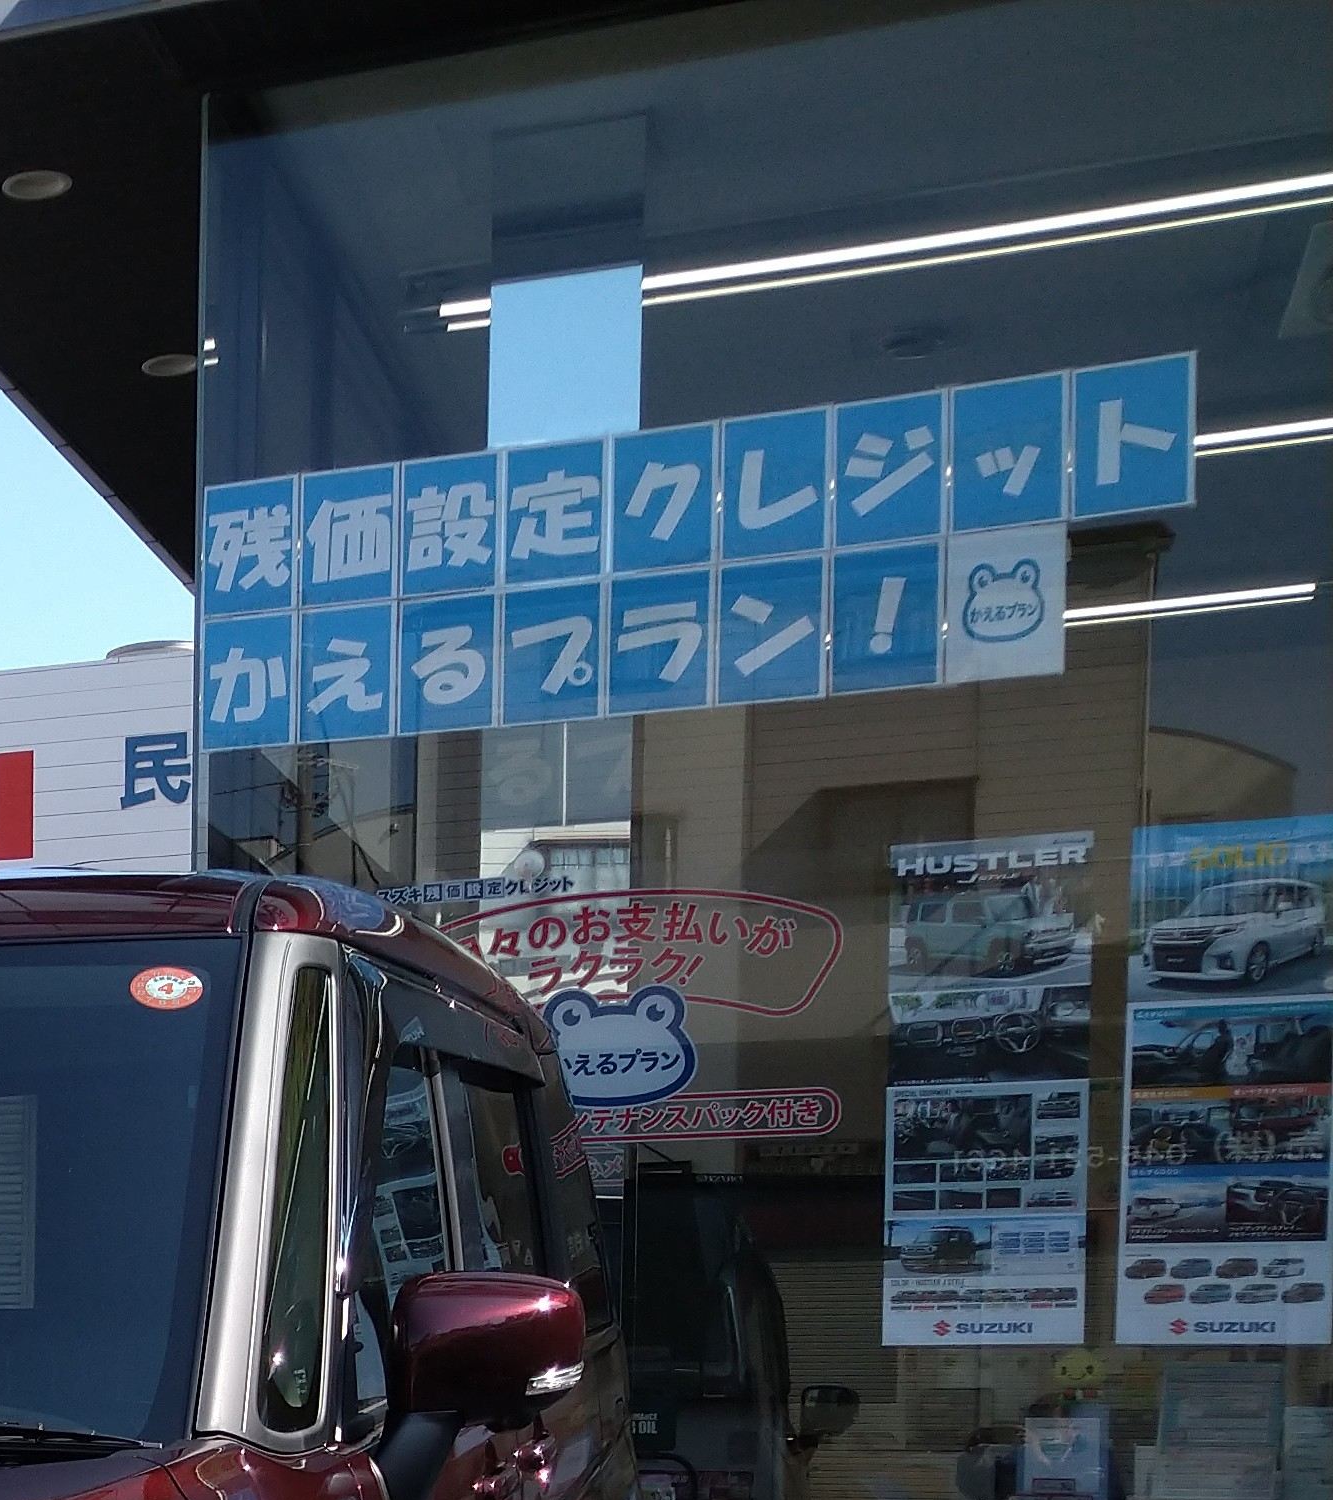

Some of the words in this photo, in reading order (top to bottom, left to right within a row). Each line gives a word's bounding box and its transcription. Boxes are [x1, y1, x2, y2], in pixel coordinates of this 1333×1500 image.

[208, 398, 1177, 594] 残価設定クレジット
[969, 600, 1039, 625] かえるプラン
[209, 575, 908, 724] かえるプラン！
[120, 732, 193, 809] 民
[897, 845, 1088, 877] HUSTLER
[528, 946, 705, 993] ラクラク!
[158, 982, 174, 995] 4
[563, 1048, 681, 1077] えるプラン
[955, 1321, 1034, 1335] SUZUKI
[1194, 1321, 1276, 1334] SUZUKI
